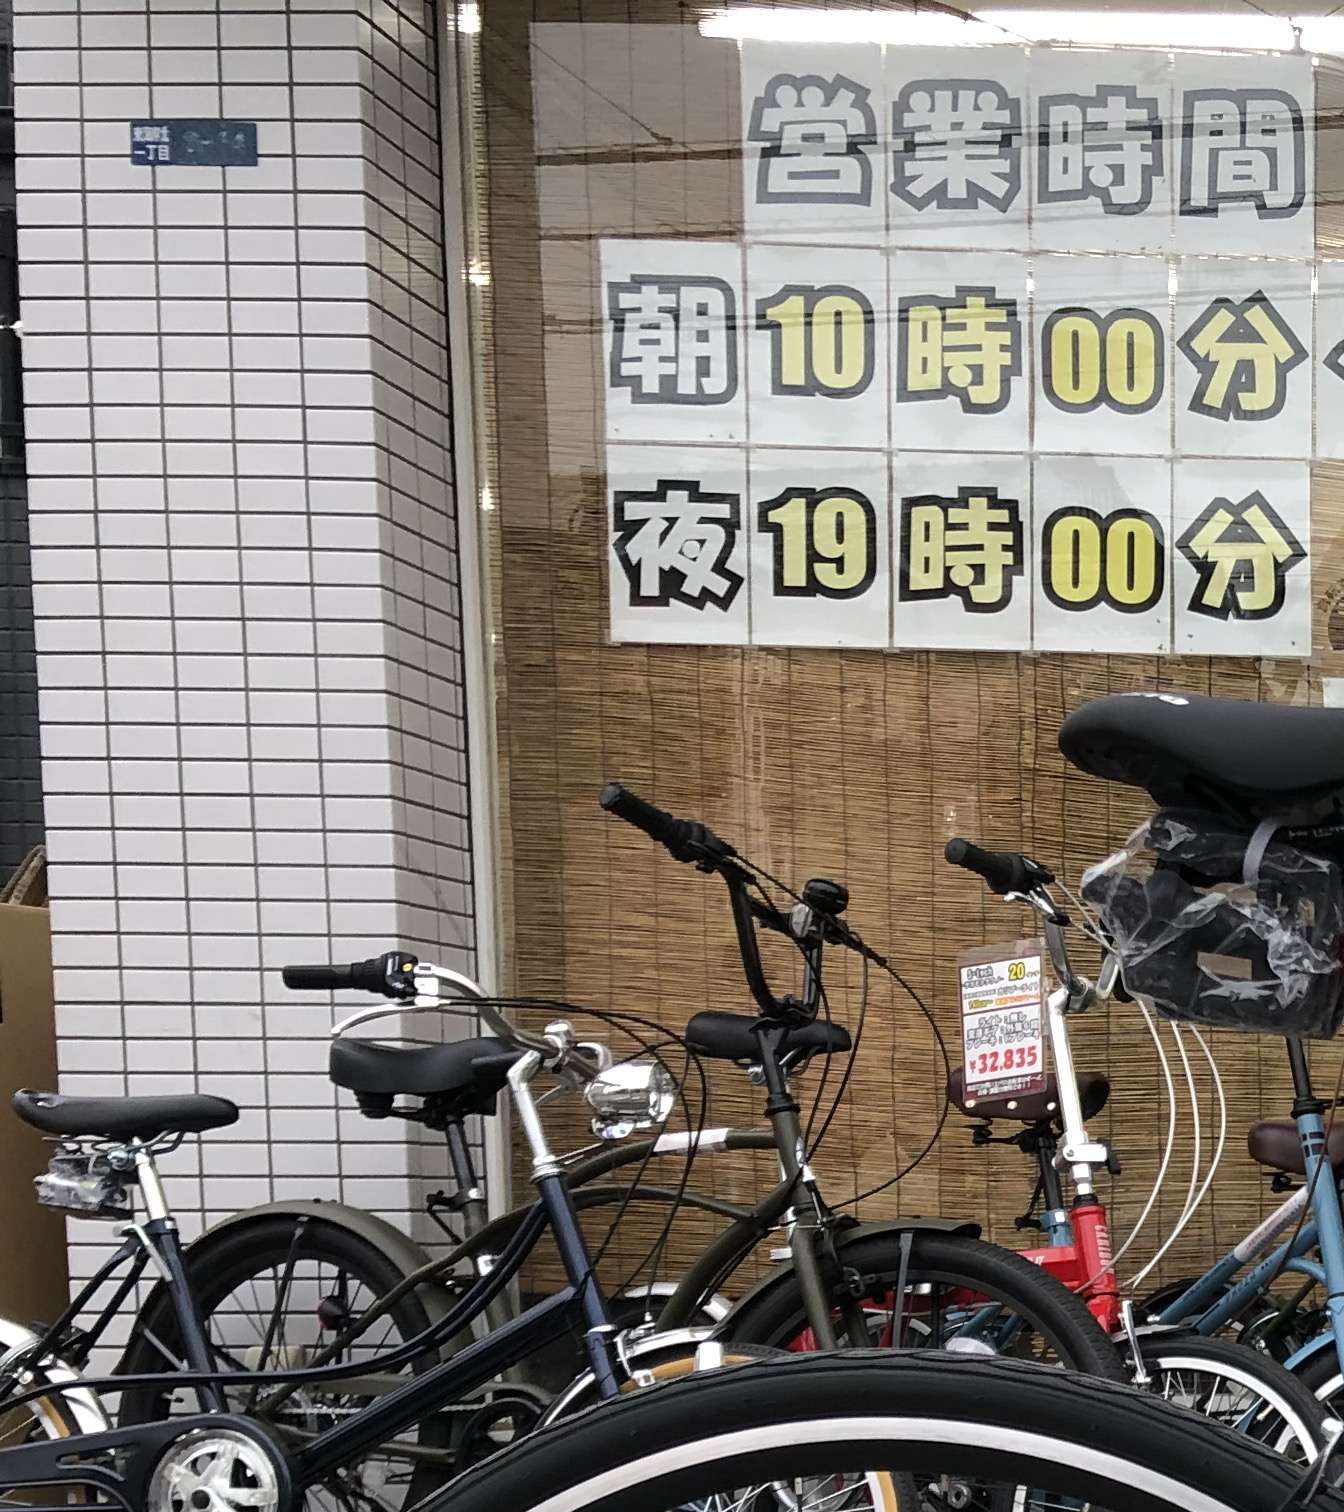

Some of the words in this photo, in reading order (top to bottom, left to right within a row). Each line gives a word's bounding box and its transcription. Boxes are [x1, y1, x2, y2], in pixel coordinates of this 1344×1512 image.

[749, 74, 1312, 219] 営業時間
[612, 480, 1308, 621] 夜19時00分
[1007, 961, 1026, 981] 20
